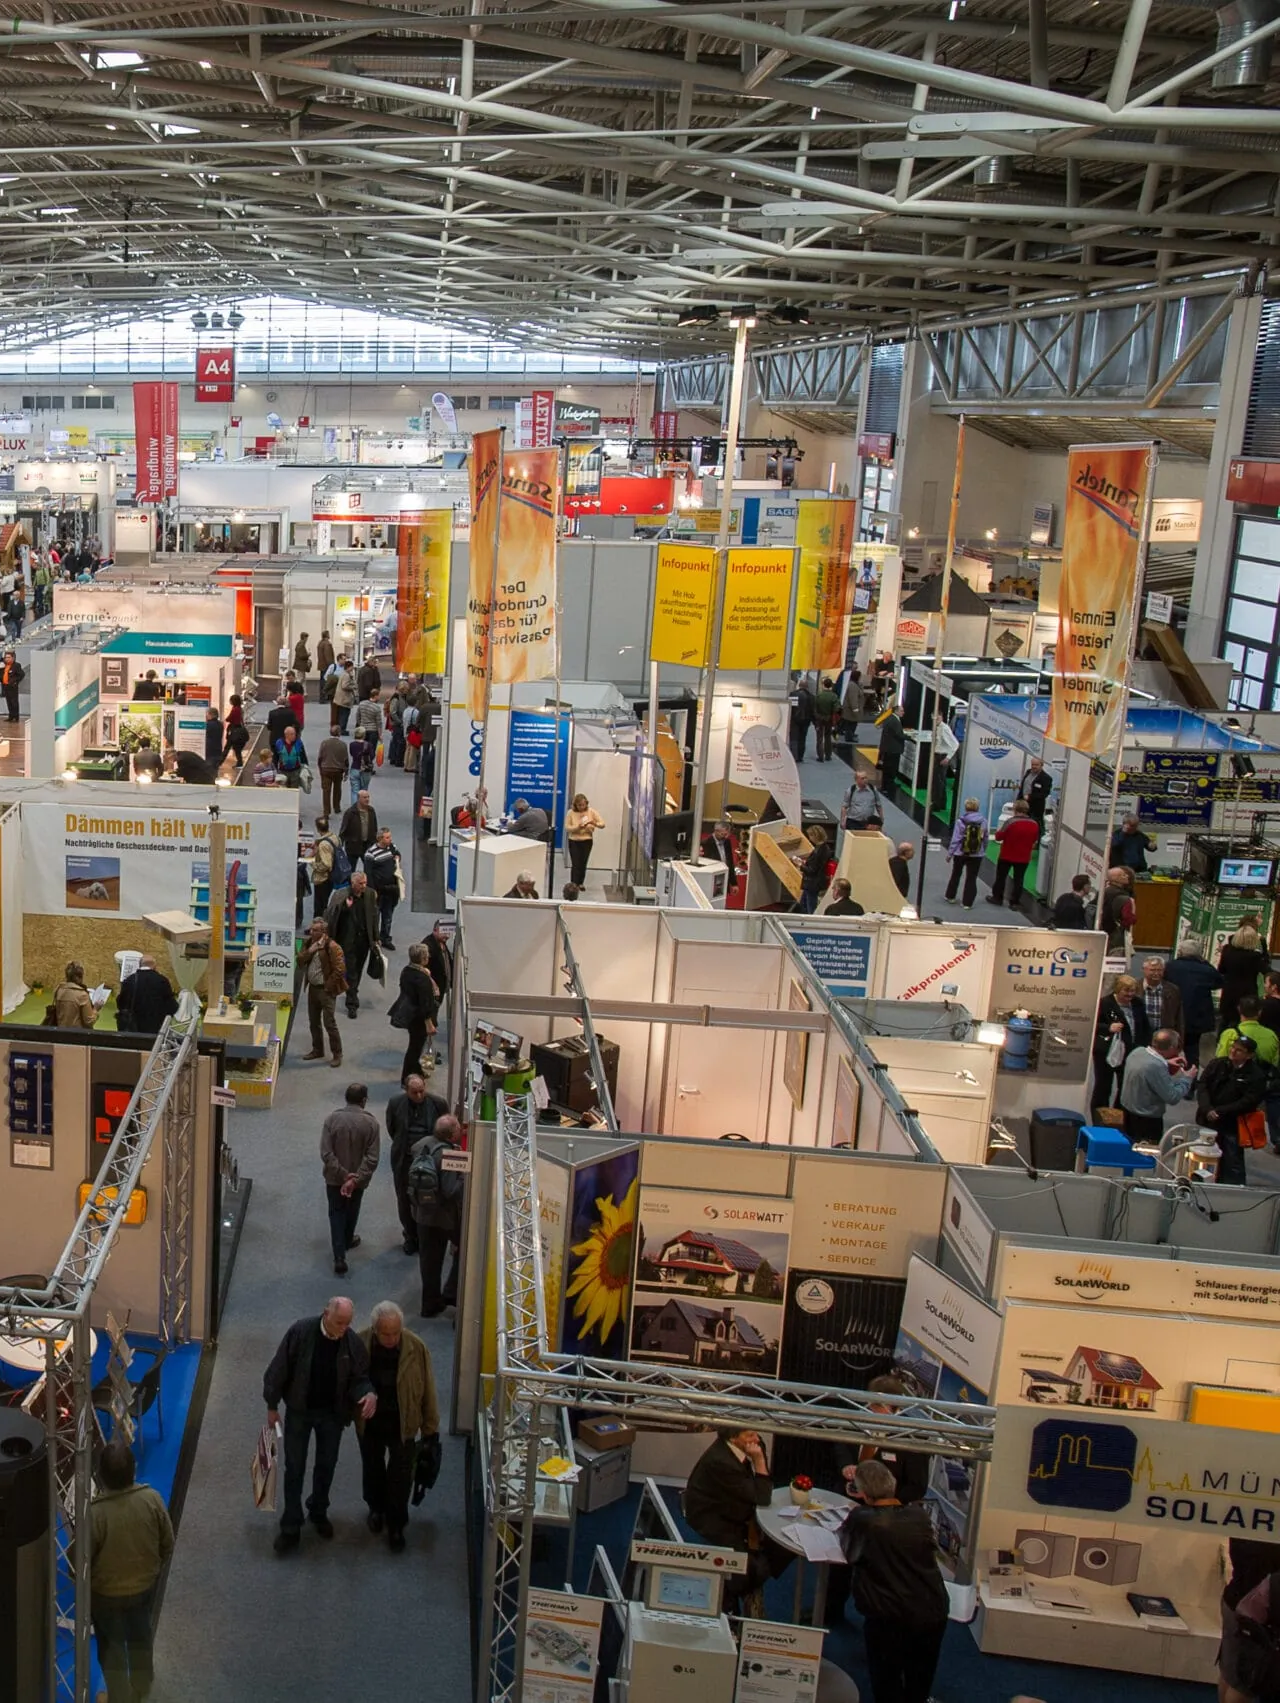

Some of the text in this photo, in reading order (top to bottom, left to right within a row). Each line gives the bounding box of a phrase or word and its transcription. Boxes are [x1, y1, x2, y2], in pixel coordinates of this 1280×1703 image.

[205, 360, 230, 375] A4
[662, 558, 710, 572] Infopunkt
[731, 563, 787, 575] Infopunkt
[733, 605, 780, 614] Anpassung auf
[59, 611, 140, 626] energie punkt
[65, 813, 251, 841] Dämmen hält wm!
[65, 838, 193, 853] Nachträgliche Geschossdecken- und
[805, 937, 836, 946] Geprüfte
[796, 944, 863, 955] ertifizierte Systeme
[1007, 947, 1054, 959] water
[256, 956, 292, 969] isofloc
[829, 953, 864, 962] Hersteller
[819, 968, 859, 977] Umgebung!
[896, 943, 976, 1000] alkprobleme?
[1007, 962, 1088, 978] cube
[1013, 984, 1076, 996] Kalkschutz System
[723, 1208, 784, 1224] SOLARWATT
[832, 1202, 898, 1216] BERATUNG
[831, 1219, 887, 1233] VERKAUF
[828, 1236, 888, 1250] MONTAGE
[827, 1253, 877, 1266] SERVICE
[1195, 1279, 1239, 1291] Schlaues
[1193, 1290, 1269, 1305] mit SolarWorld
[815, 1338, 892, 1358] SOLARWOR
[725, 1559, 738, 1567] LG
